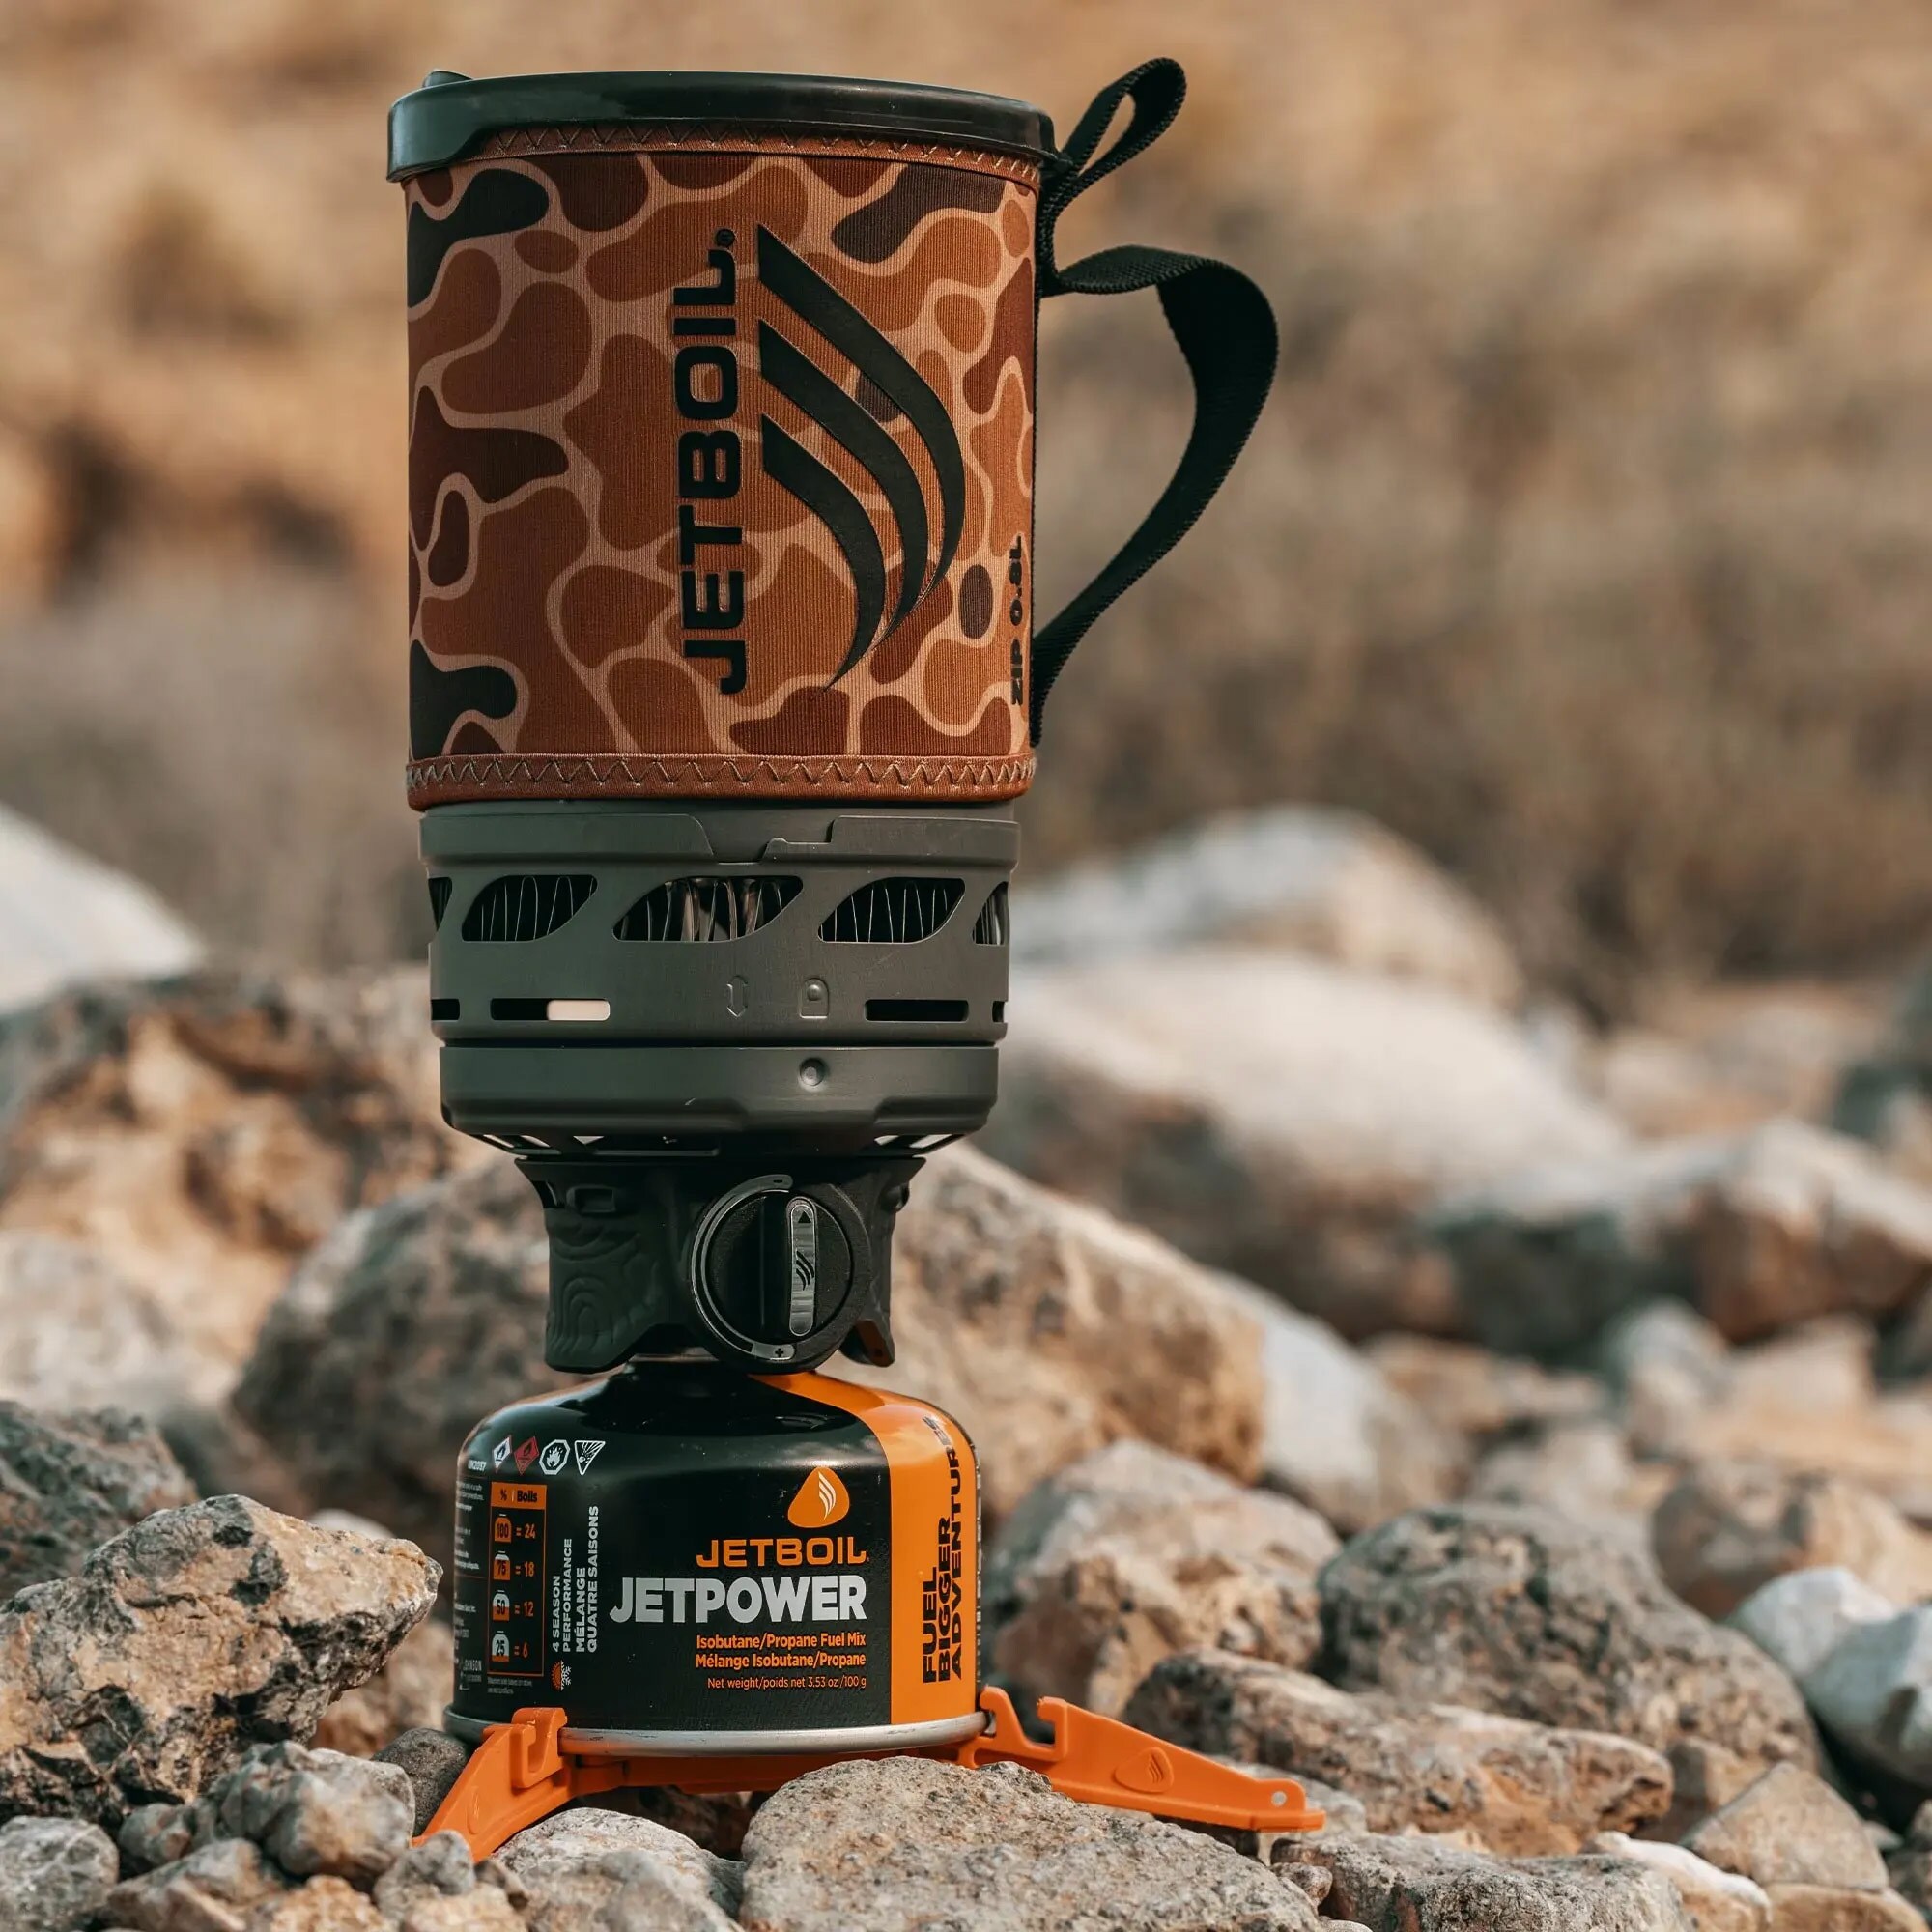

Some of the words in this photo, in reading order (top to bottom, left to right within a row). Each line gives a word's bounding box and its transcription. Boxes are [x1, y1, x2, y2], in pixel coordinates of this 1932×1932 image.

[672, 247, 748, 695] JETBOIL
[1009, 535, 1023, 627] 0.8L
[1009, 638, 1024, 706] ZIP
[517, 1490, 538, 1503] Boils
[497, 1522, 509, 1539] 100
[525, 1523, 536, 1539] 24
[588, 1505, 599, 1578] SAISONS
[696, 1536, 867, 1568] JETBOIL
[497, 1560, 507, 1577] 75
[524, 1561, 535, 1577] 18
[496, 1600, 505, 1615] 50
[523, 1601, 534, 1617] 12
[552, 1575, 561, 1640] SEASON
[562, 1538, 573, 1653] PERFORMANCE
[574, 1567, 586, 1653] MÉLANGE
[587, 1580, 599, 1654] QUATRE
[609, 1575, 867, 1624] JETPOWER
[938, 1517, 952, 1682] BIGGER
[496, 1639, 506, 1657] 25
[523, 1641, 528, 1658] 6
[553, 1641, 560, 1653] 4
[696, 1633, 817, 1649] Isobutane/Propane
[820, 1633, 845, 1646] Fuel
[847, 1633, 867, 1646] Mix
[923, 1567, 937, 1683] FUEL
[696, 1654, 750, 1670] Mélange
[753, 1653, 867, 1669] Isobutane/Propane
[707, 1677, 725, 1689] Net
[726, 1676, 789, 1690] weight/poids
[790, 1677, 806, 1689] net
[808, 1677, 826, 1688] 3.53
[828, 1679, 838, 1688] oz
[839, 1675, 859, 1688] /100
[860, 1678, 867, 1689] g
